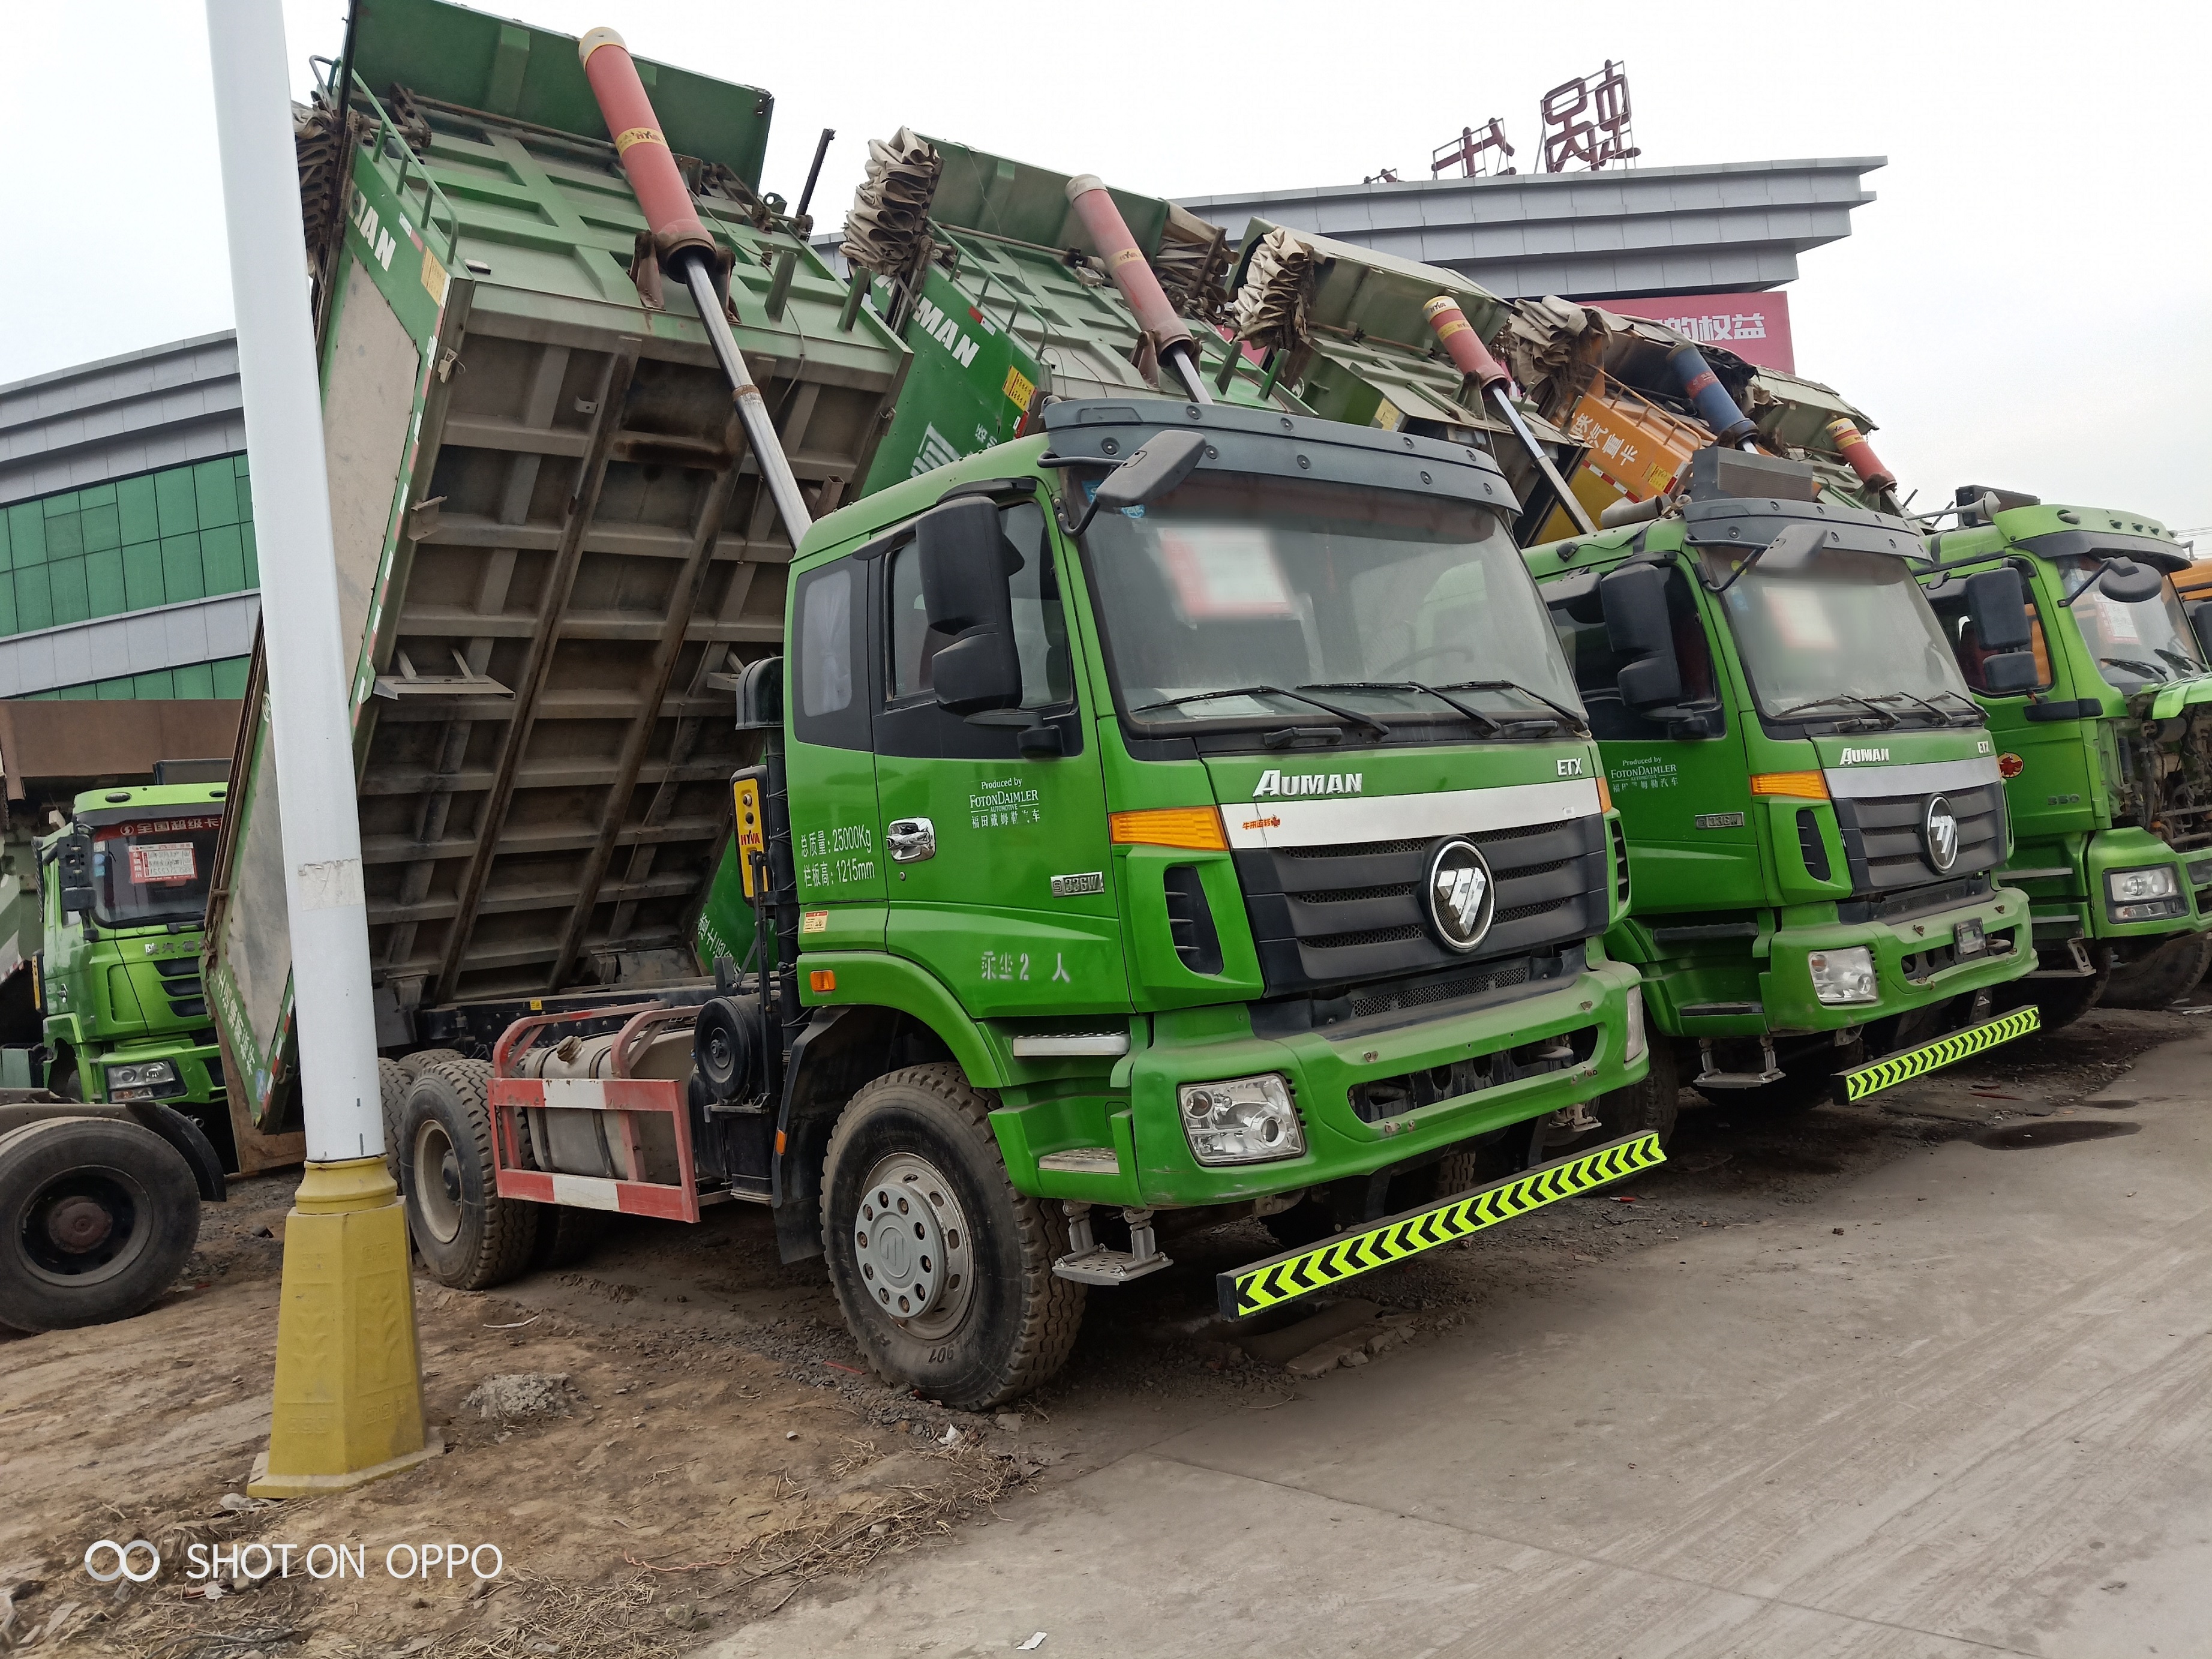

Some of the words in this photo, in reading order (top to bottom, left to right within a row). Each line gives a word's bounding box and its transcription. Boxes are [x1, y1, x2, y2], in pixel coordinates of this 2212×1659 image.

[1622, 757, 1652, 766] Produced
[1839, 748, 1890, 766] AUMAN
[982, 778, 1012, 790] Produced
[1014, 777, 1022, 787] by
[1252, 770, 1362, 797] AUMAN
[1557, 758, 1583, 777] ETX
[991, 803, 1018, 812] AUTOMOTIVE
[136, 817, 223, 834] 全国超级卡
[741, 830, 760, 846] HYVA
